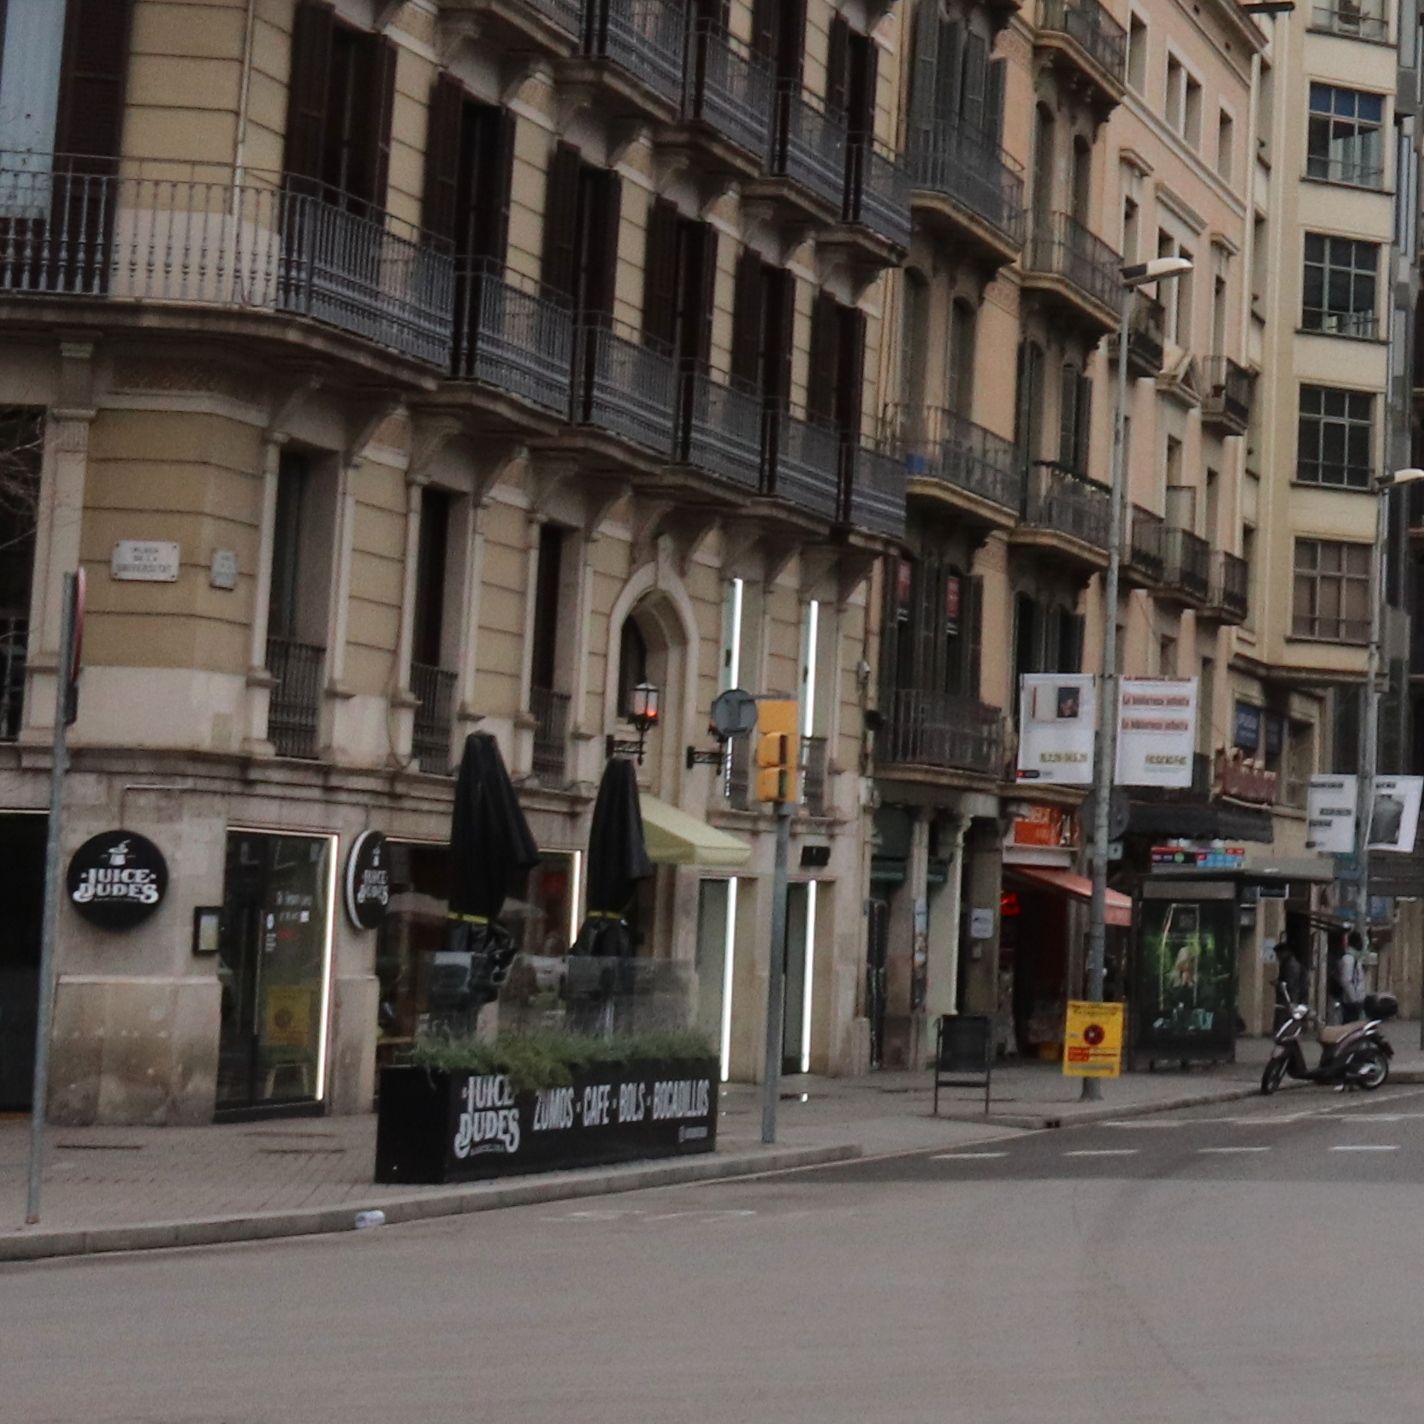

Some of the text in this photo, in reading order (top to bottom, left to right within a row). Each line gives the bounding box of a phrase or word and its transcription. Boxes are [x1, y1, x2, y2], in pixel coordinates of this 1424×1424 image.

[72, 882, 159, 904] DUDES
[88, 868, 151, 885] JUICE
[466, 1074, 515, 1114] JUICE
[532, 1086, 575, 1131] ZUMOS
[618, 1082, 646, 1123] BOLS
[652, 1078, 711, 1121] BOCADILLOS
[454, 1108, 521, 1159] DUDES
